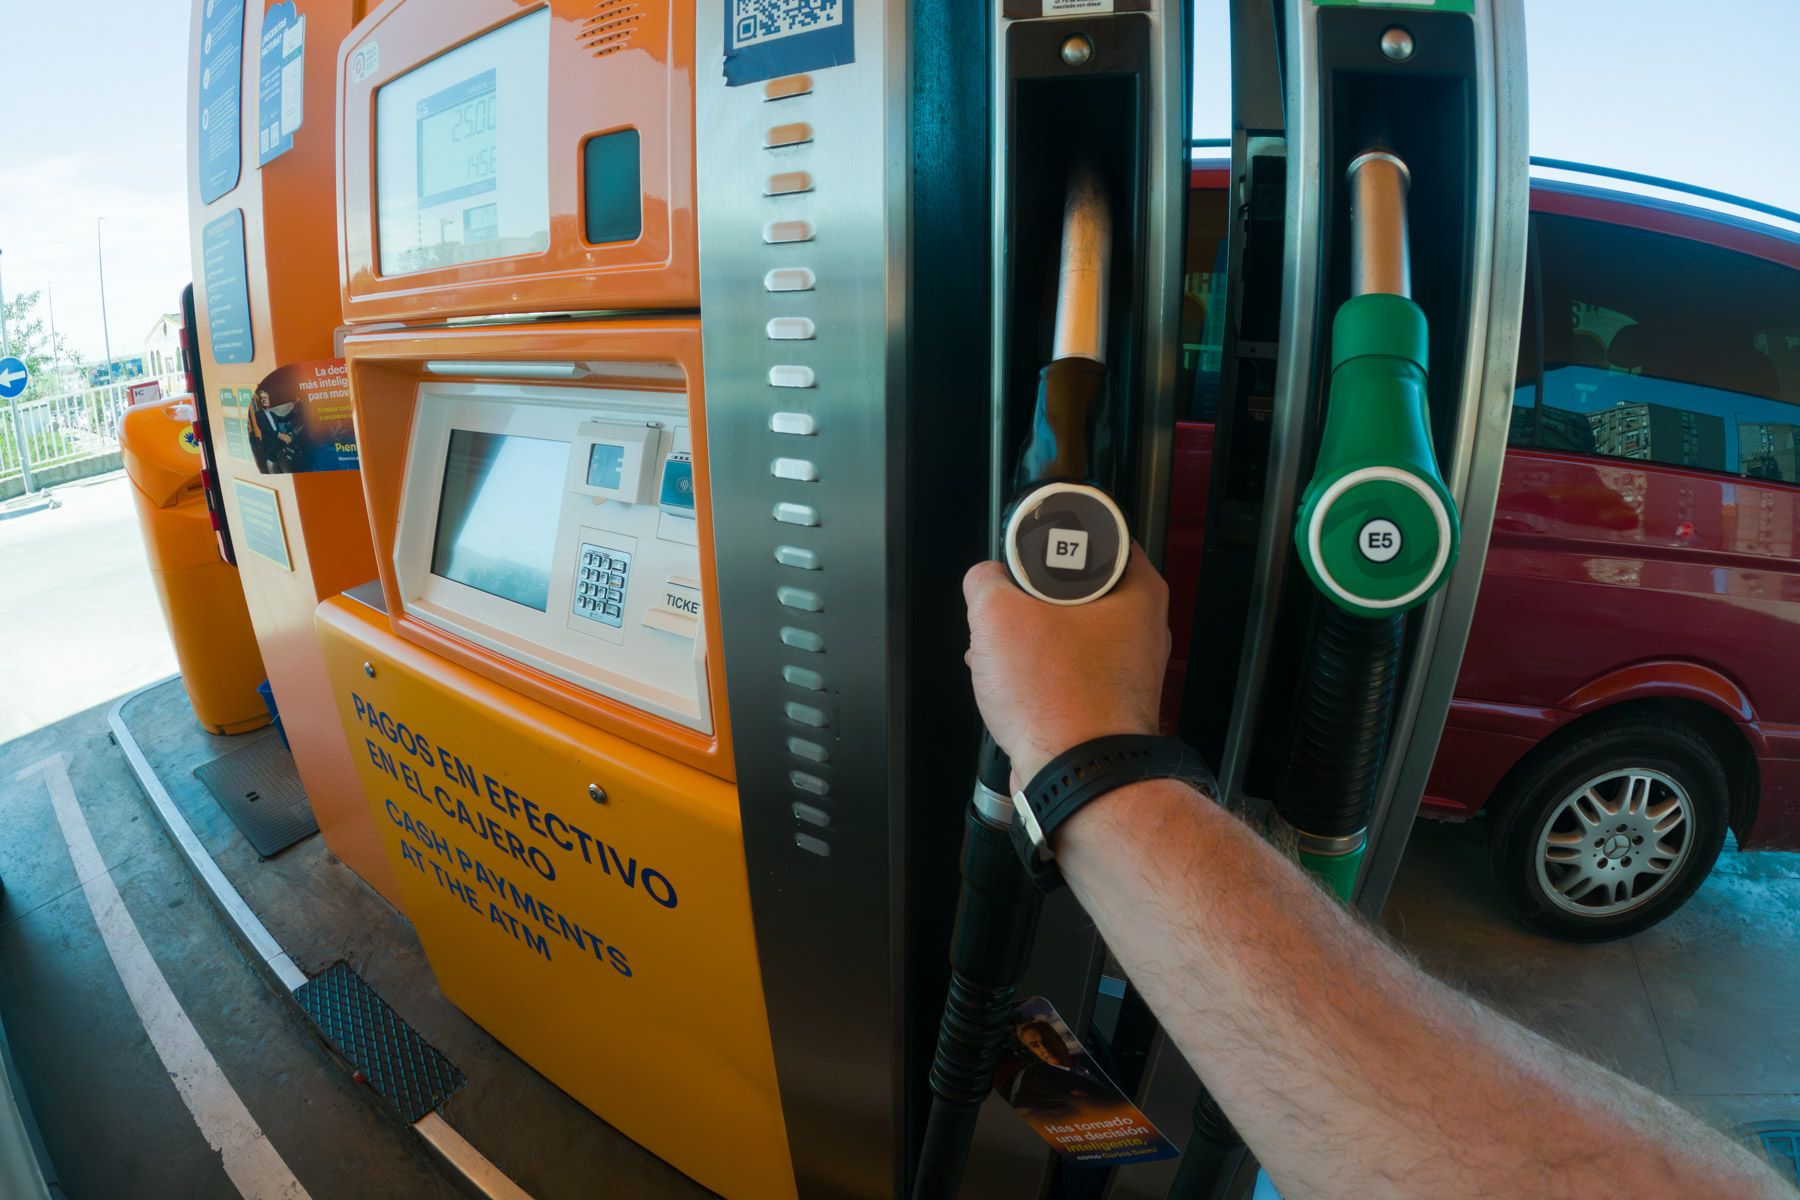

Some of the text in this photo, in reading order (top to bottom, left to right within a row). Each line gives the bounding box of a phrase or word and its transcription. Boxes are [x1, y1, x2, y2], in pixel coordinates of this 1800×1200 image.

[315, 364, 347, 377] La deci
[299, 376, 348, 390] más intelig
[308, 391, 328, 403] para
[1055, 540, 1080, 557] B7
[1367, 531, 1393, 550] E5
[666, 593, 701, 614] TICKE
[351, 691, 678, 909] PAGOS EN EFECTIVO
[365, 737, 556, 882] EN EL CAJERO
[385, 798, 633, 978] CASH PAYMENTS
[400, 838, 552, 962] AT THE ATM
[1044, 1116, 1134, 1135] Has tomado
[1055, 1126, 1149, 1144] una decisión
